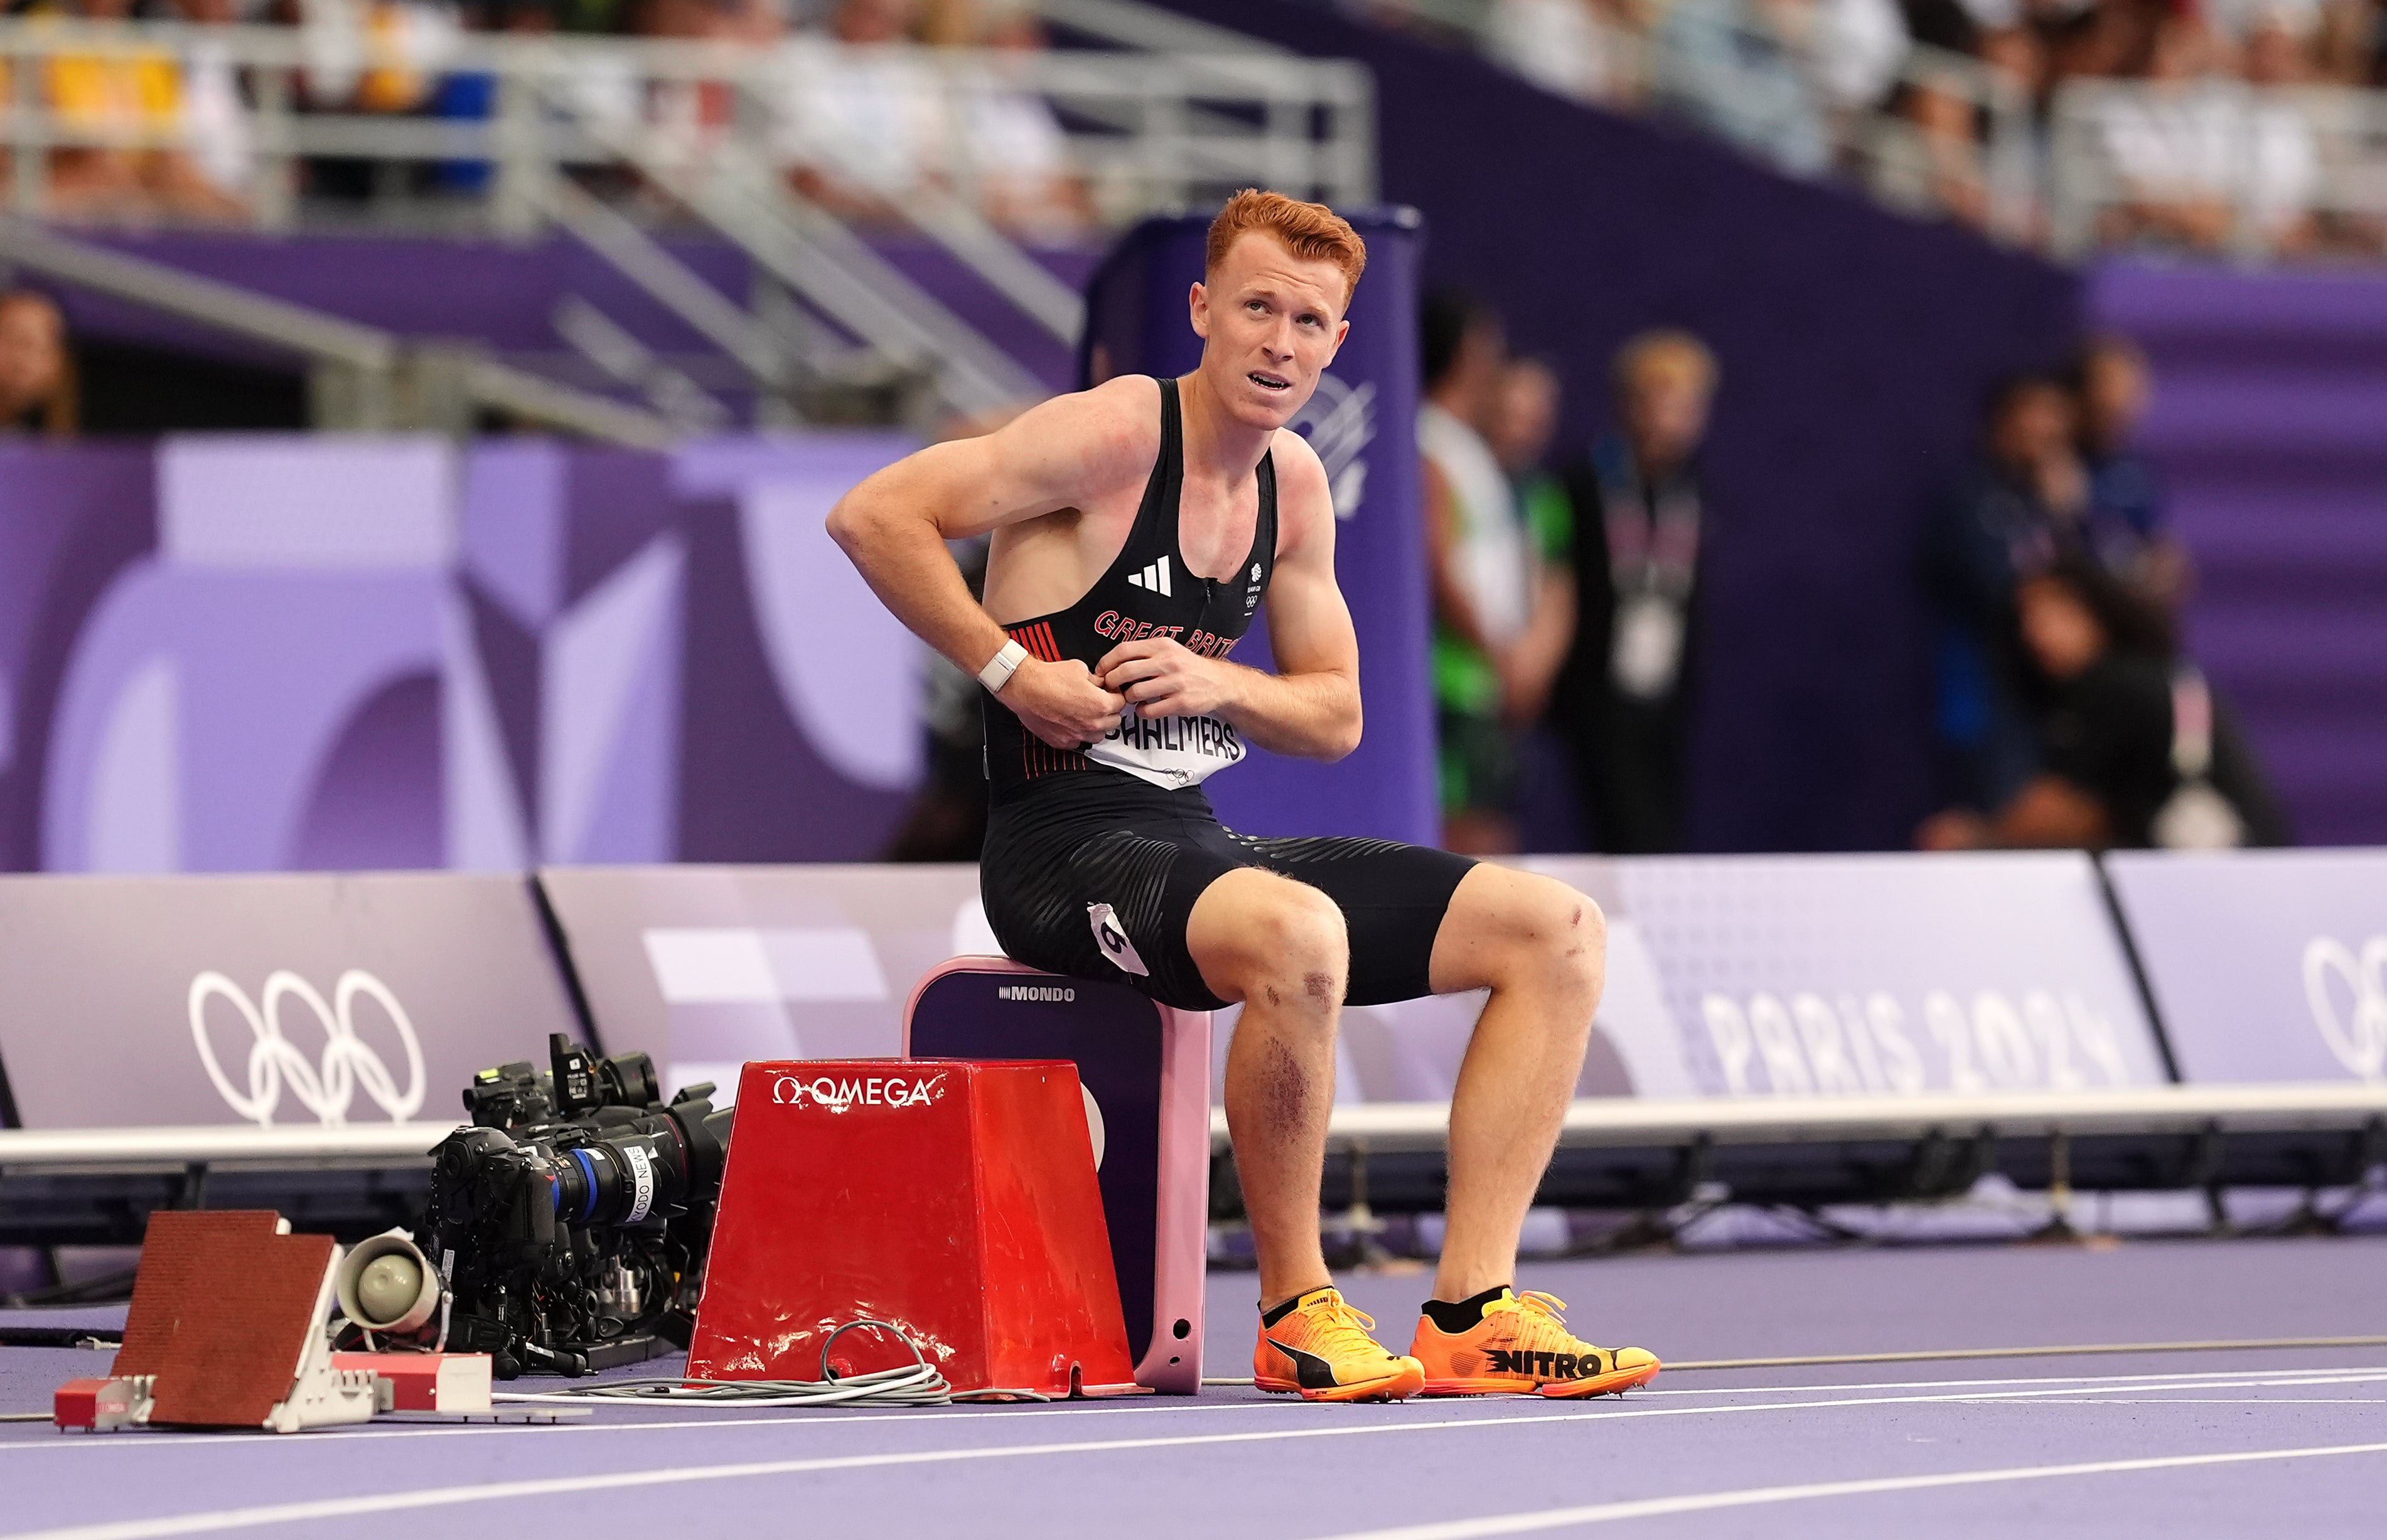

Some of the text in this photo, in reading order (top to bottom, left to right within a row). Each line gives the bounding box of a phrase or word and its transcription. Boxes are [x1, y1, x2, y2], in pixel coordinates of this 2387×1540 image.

[1011, 986, 1075, 1002] MONDO
[1702, 990, 2130, 1096] PARIS 2024
[811, 1077, 931, 1106] OMEGA
[628, 1147, 650, 1221] KYODO NEWS
[1479, 1349, 1601, 1379] NITRO
